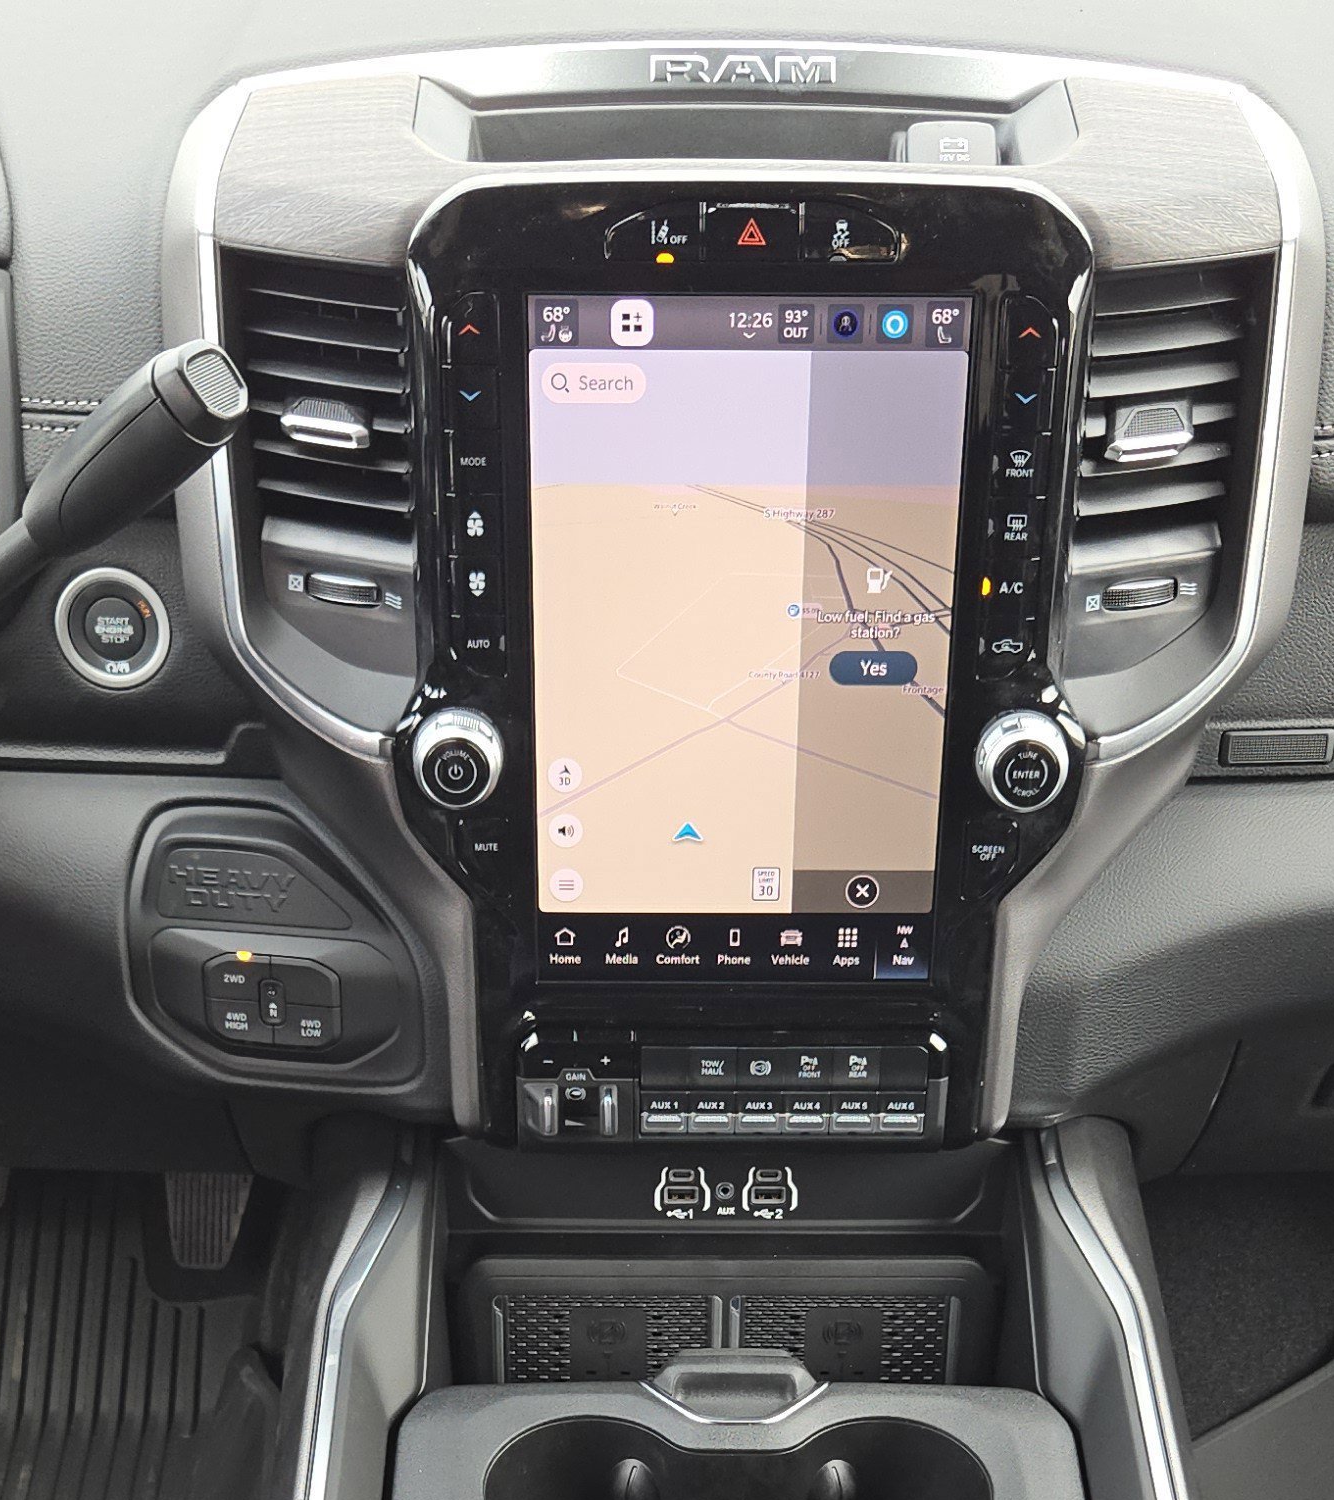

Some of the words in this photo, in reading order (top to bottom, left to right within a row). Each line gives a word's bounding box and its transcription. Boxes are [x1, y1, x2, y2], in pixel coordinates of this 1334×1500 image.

[649, 53, 837, 84] RAM
[670, 235, 688, 245] OFF
[832, 238, 851, 248] OFF
[542, 305, 571, 322] 68°
[784, 310, 809, 325] 93°
[931, 308, 960, 325] 68°
[728, 312, 773, 328] 12:26
[783, 327, 808, 339] OUT
[578, 375, 634, 392] Search
[460, 457, 487, 466] MODE
[1005, 468, 1034, 478] FRONT
[772, 508, 815, 521] Highway
[816, 508, 835, 519] 287
[1004, 532, 1028, 541] REAR
[999, 582, 1024, 594] A/C
[97, 616, 130, 625] START
[817, 611, 844, 624] Low
[844, 610, 871, 625] fuel.
[873, 611, 902, 624] Find
[903, 614, 912, 624] a
[913, 613, 936, 626] gas
[849, 626, 901, 639] station?
[100, 634, 130, 643] STOP
[467, 639, 490, 649] AUTO
[859, 660, 888, 677] Yes
[748, 670, 777, 681] County
[778, 670, 798, 679] Road
[902, 684, 945, 696] Frontage
[442, 749, 470, 761] VOLUME
[1017, 751, 1039, 760] TUNE
[1012, 770, 1040, 779] ENTER
[558, 776, 571, 786] 3D
[474, 843, 499, 852] MUTE
[971, 845, 1006, 854] SCREEN
[979, 853, 998, 861] OFF
[169, 865, 296, 891] HEAVY
[758, 885, 773, 896] 30
[185, 887, 288, 913] DUTY
[896, 926, 914, 935] NW
[548, 953, 582, 966] Home
[605, 953, 639, 966] Media
[656, 953, 701, 966] Comfort
[717, 953, 751, 966] Phone
[771, 953, 810, 966] Vehicle
[832, 954, 860, 968] Apps
[892, 954, 915, 966] Nav
[223, 974, 246, 984] 2WD
[226, 1012, 247, 1022] 4WD
[269, 1008, 278, 1018] N
[225, 1021, 249, 1031] HIGH
[300, 1019, 322, 1029] 4WD
[300, 1028, 322, 1037] LOW
[565, 1072, 586, 1081] GAIN
[700, 1067, 725, 1076] HAUL
[798, 1071, 821, 1079] FRONT
[650, 1101, 671, 1110] AUX
[673, 1101, 679, 1110] 1
[697, 1101, 718, 1110] AUX
[718, 1101, 725, 1110] 2
[745, 1101, 765, 1110] AUX
[766, 1101, 773, 1110] 3
[793, 1101, 813, 1110] AUX
[813, 1101, 821, 1110] 4
[840, 1101, 861, 1110] AUX
[887, 1101, 907, 1110] AUX
[687, 1208, 694, 1220] 1
[716, 1206, 736, 1216] AUX
[774, 1208, 784, 1220] 2
